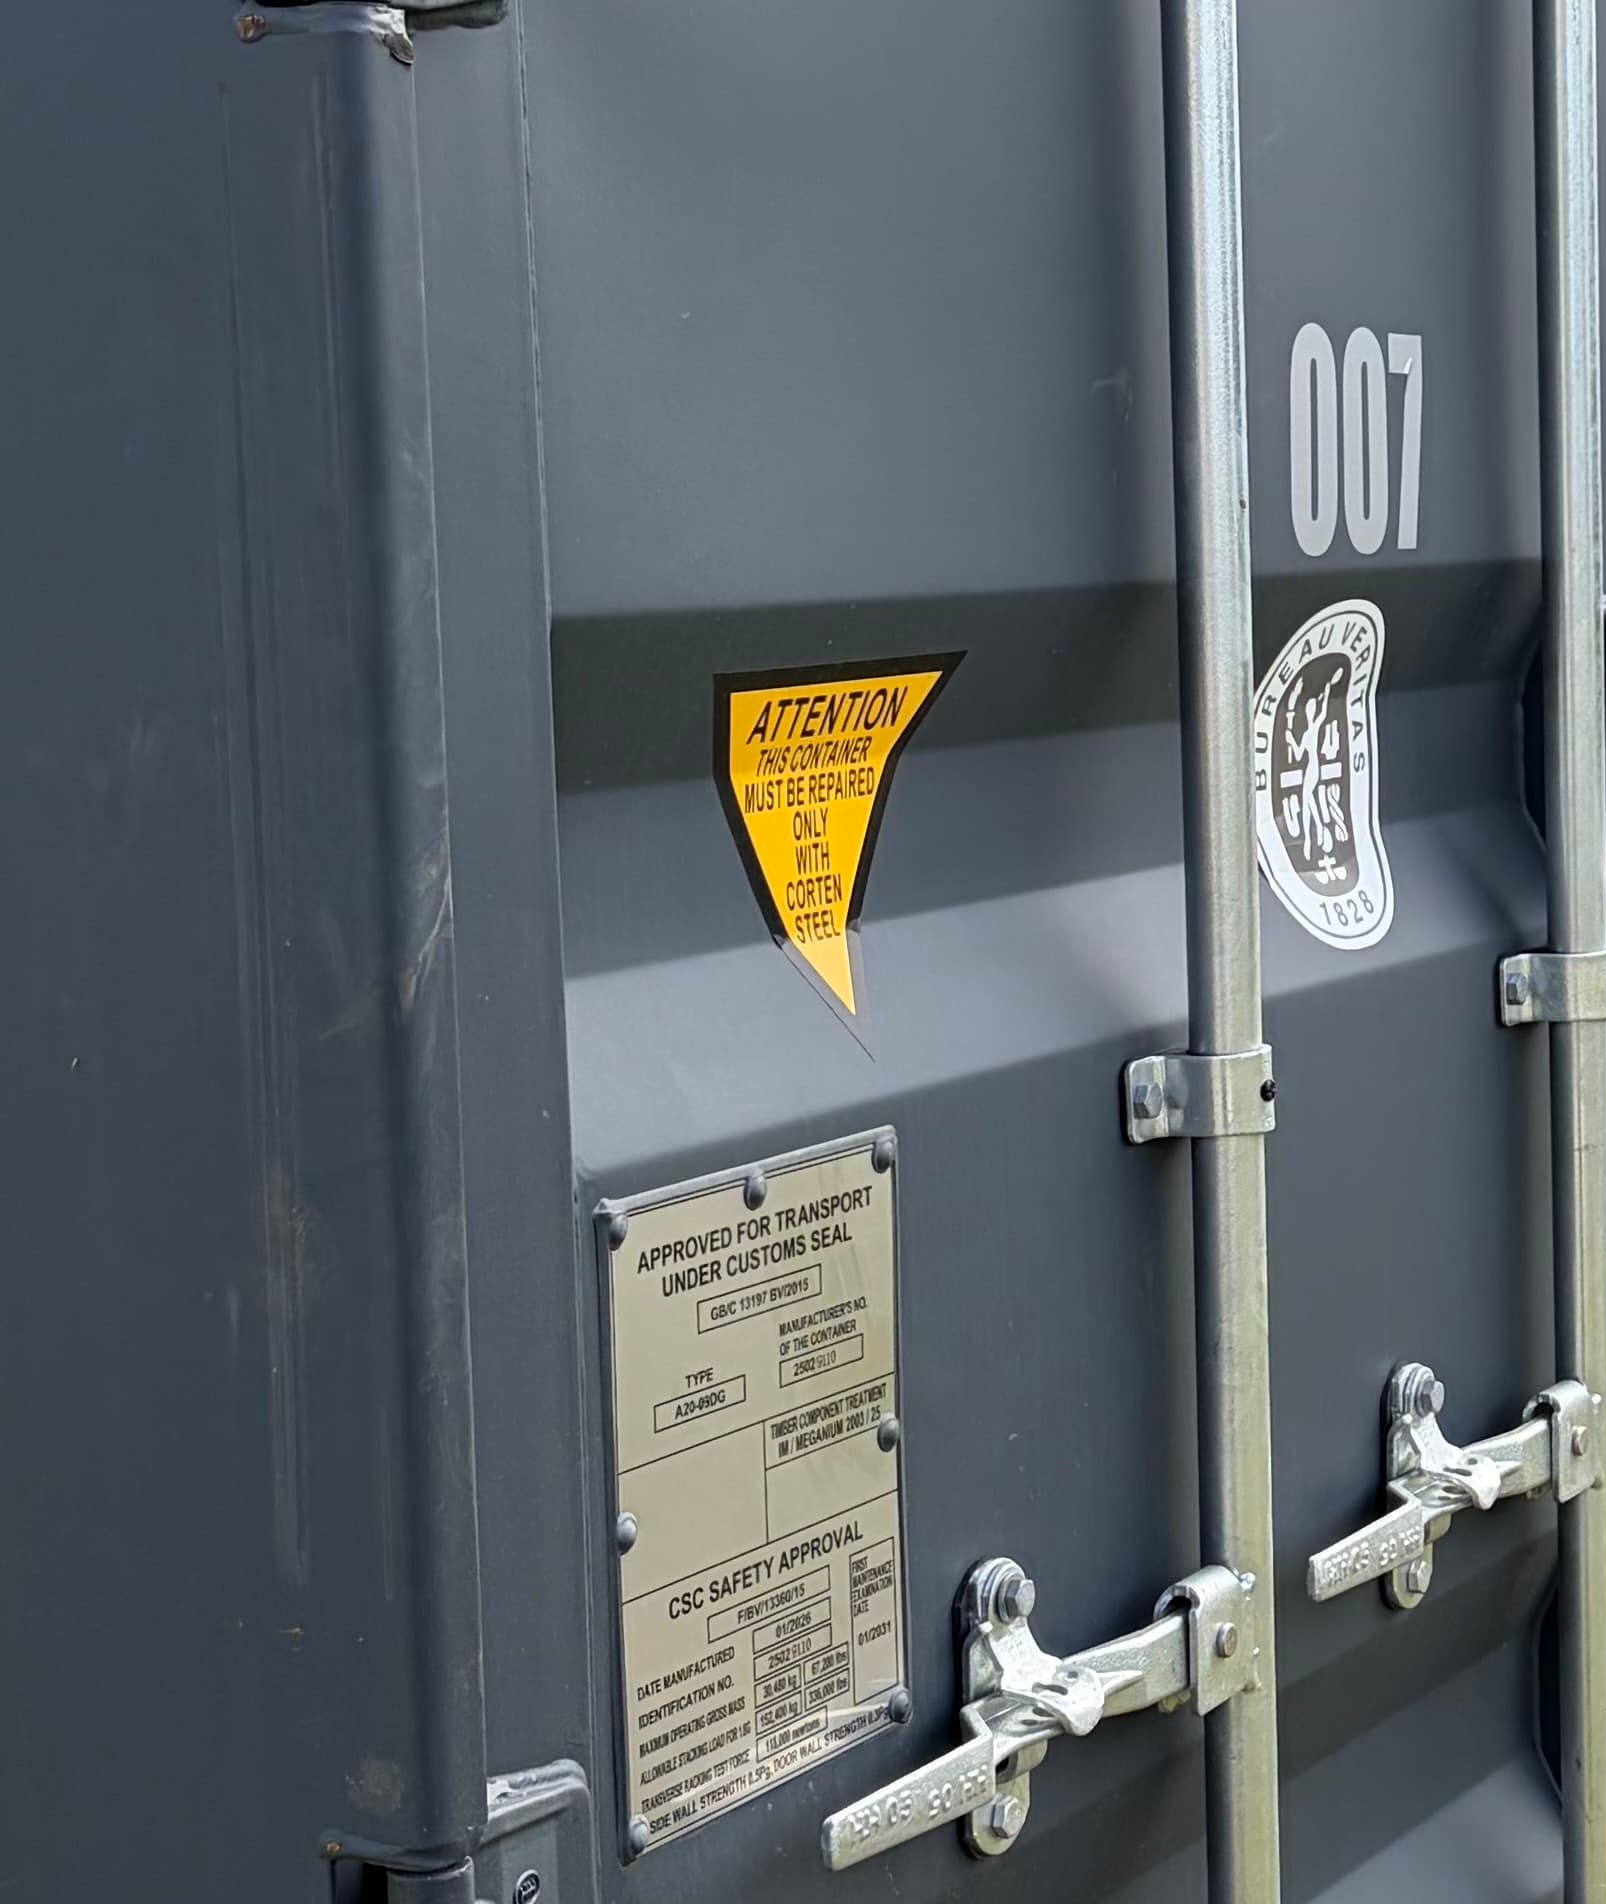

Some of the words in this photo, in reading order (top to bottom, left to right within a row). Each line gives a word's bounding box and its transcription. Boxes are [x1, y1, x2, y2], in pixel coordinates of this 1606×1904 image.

[1290, 322, 1423, 557] 007
[746, 686, 908, 744] ATTENTION
[1255, 624, 1334, 793] BUREAU
[1341, 621, 1371, 774] VERITAS
[757, 746, 790, 776] THIS
[790, 736, 872, 772] CONTAINER
[745, 779, 783, 813] MUST
[786, 774, 805, 807] BE
[809, 766, 875, 802] REPAIRED
[793, 808, 828, 840] ONLY
[796, 841, 830, 874] WITH
[786, 874, 842, 911] CORTEN
[1320, 890, 1374, 926] 1828
[795, 909, 840, 943] STEEL
[638, 1227, 732, 1274] APPROVED
[737, 1215, 771, 1245] FOR
[775, 1186, 873, 1232] TRANSPORT
[662, 1259, 722, 1297] UNDER
[726, 1235, 806, 1277] CUSTOMS
[811, 1222, 853, 1252] SEAL
[711, 1300, 737, 1321] GB/C
[779, 1301, 853, 1336] MANUFACTURER'S
[854, 1296, 868, 1315] NO.
[779, 1342, 792, 1357] OF
[793, 1335, 810, 1352] THE
[811, 1319, 857, 1347] CONTAINER
[685, 1367, 714, 1388] TYPE
[770, 1418, 800, 1440] TIMBER
[800, 1399, 844, 1430] COMPONENT
[845, 1382, 888, 1410] TREATMENT
[669, 1587, 704, 1620] CSC
[709, 1556, 775, 1603] SAFETY
[778, 1520, 864, 1574] APPROVAL
[852, 1556, 868, 1575] FIRST
[852, 1560, 894, 1588] MAINTENANCE
[852, 1575, 893, 1604] EXAMINATION
[853, 1601, 870, 1617] DATE
[637, 1679, 661, 1701] DATE
[663, 1646, 735, 1688] MANUFACTURED
[638, 1684, 716, 1730] IDENTIFICATION
[717, 1674, 734, 1692] NO.
[639, 1732, 670, 1759] MAXIMUM
[706, 1707, 728, 1728] GROSS
[650, 1814, 671, 1835] SIDE
[673, 1800, 698, 1826] WALL
[700, 1777, 747, 1810] STRENGTH
[800, 1736, 822, 1762] WALL
[824, 1716, 867, 1746] STRENGTH
